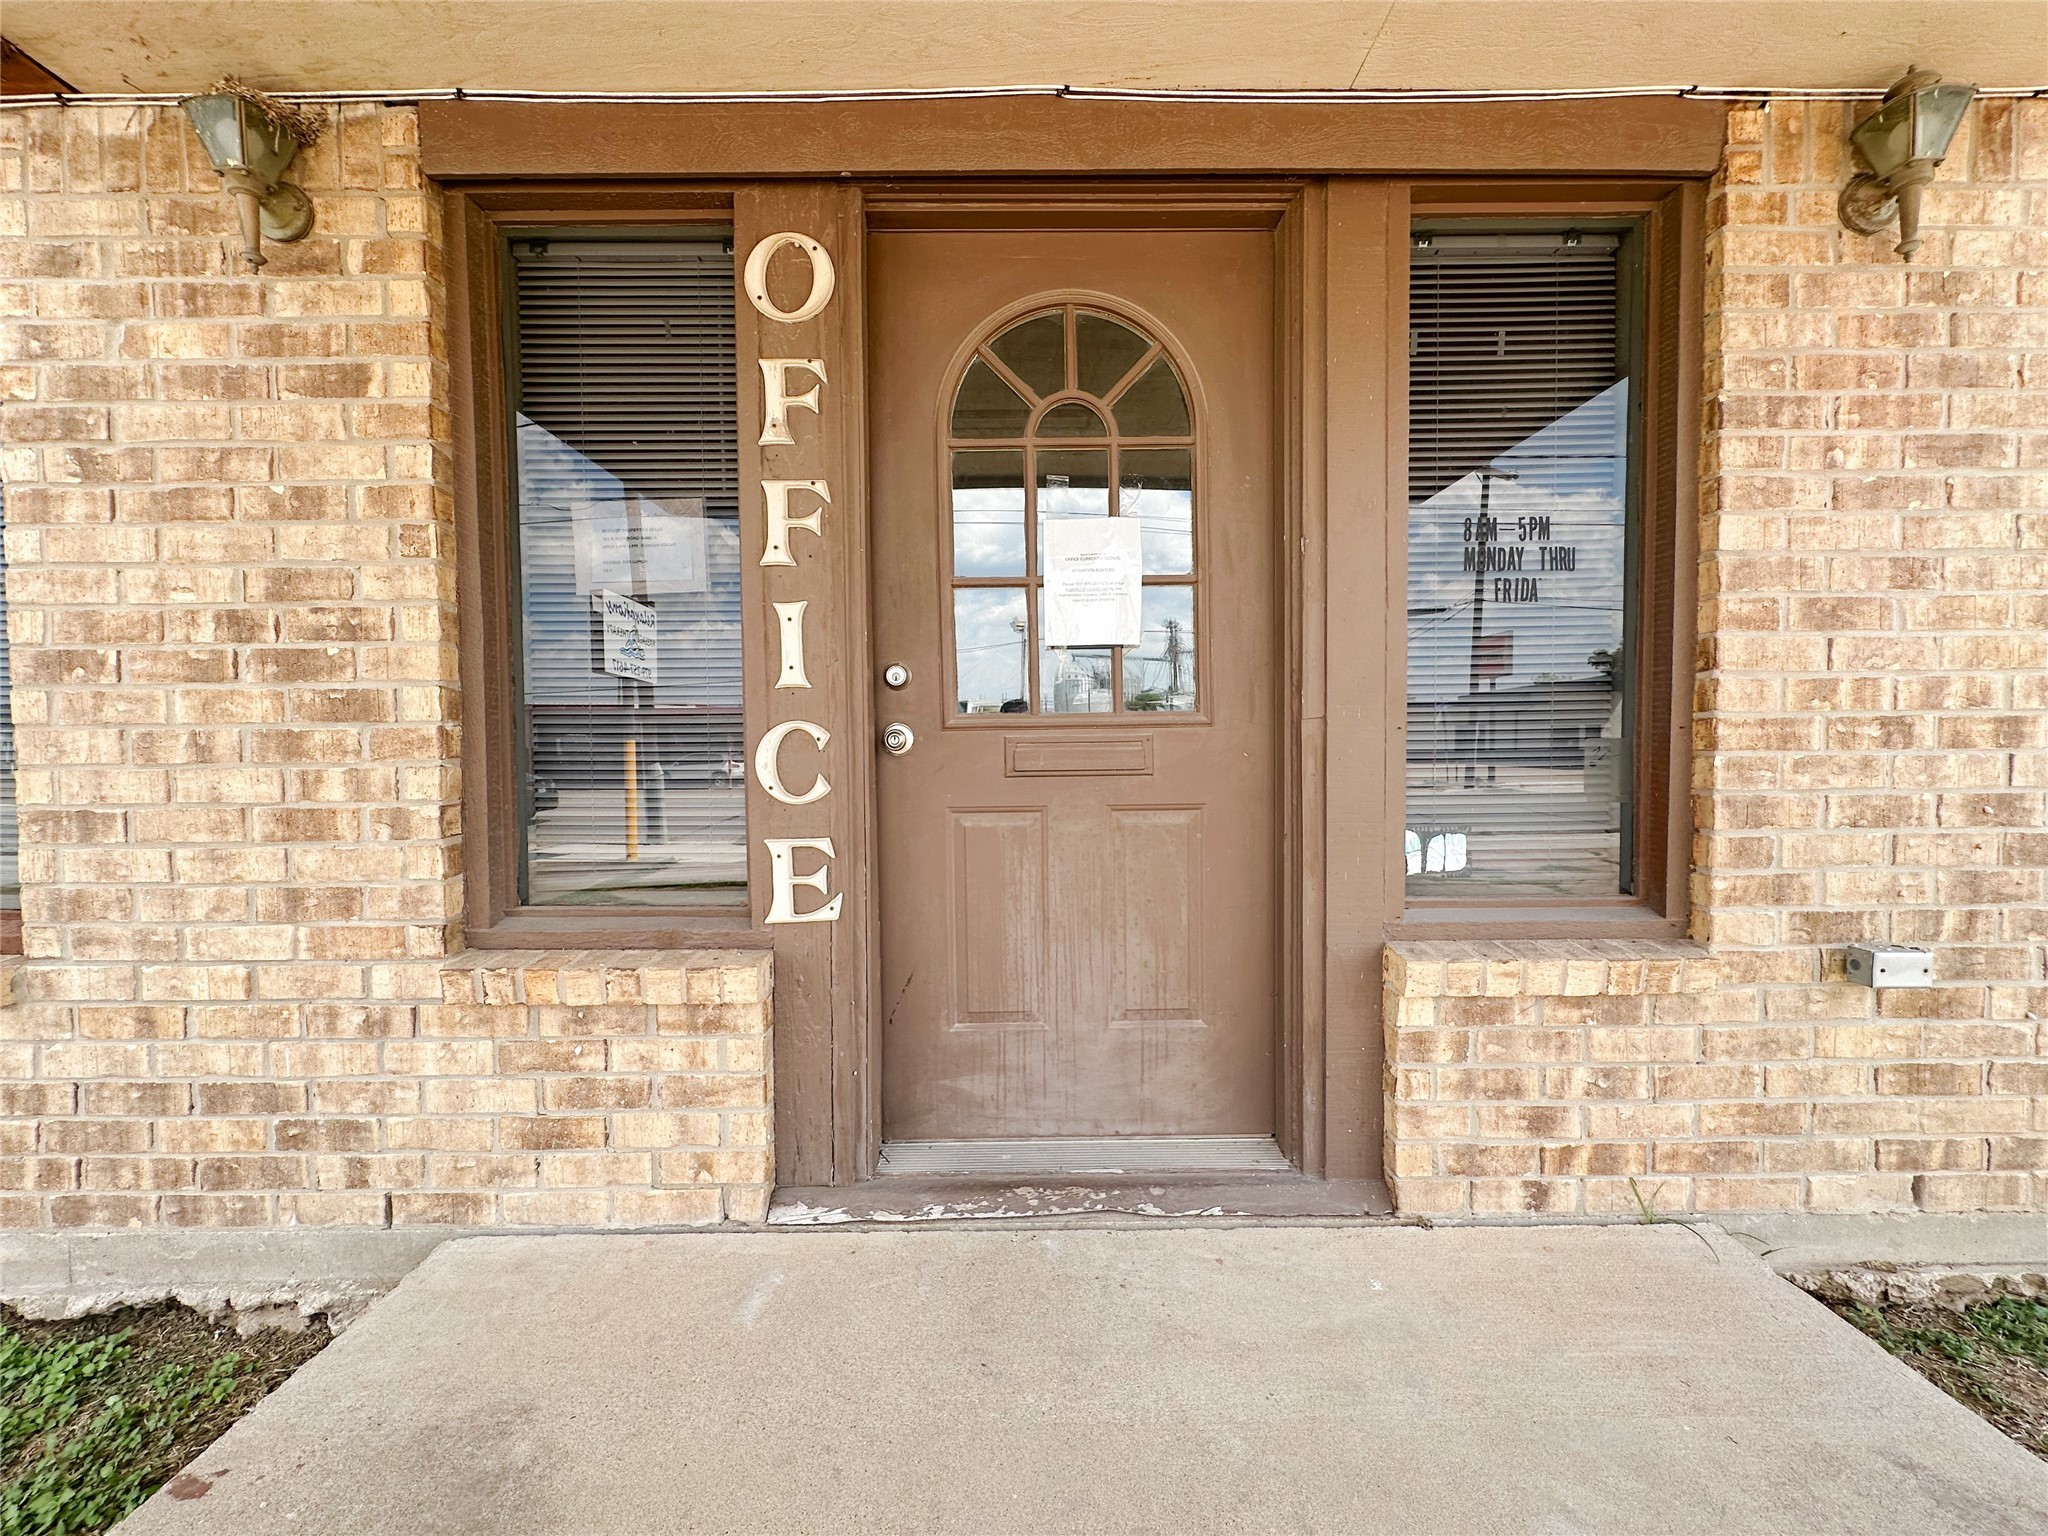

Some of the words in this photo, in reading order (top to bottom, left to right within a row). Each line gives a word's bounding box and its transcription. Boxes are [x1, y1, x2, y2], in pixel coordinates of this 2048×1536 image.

[1463, 546, 1525, 572] MONDAY
[1539, 546, 1576, 572] THRU
[743, 231, 843, 924] OFFICE
[1494, 577, 1542, 602] FRIDA
